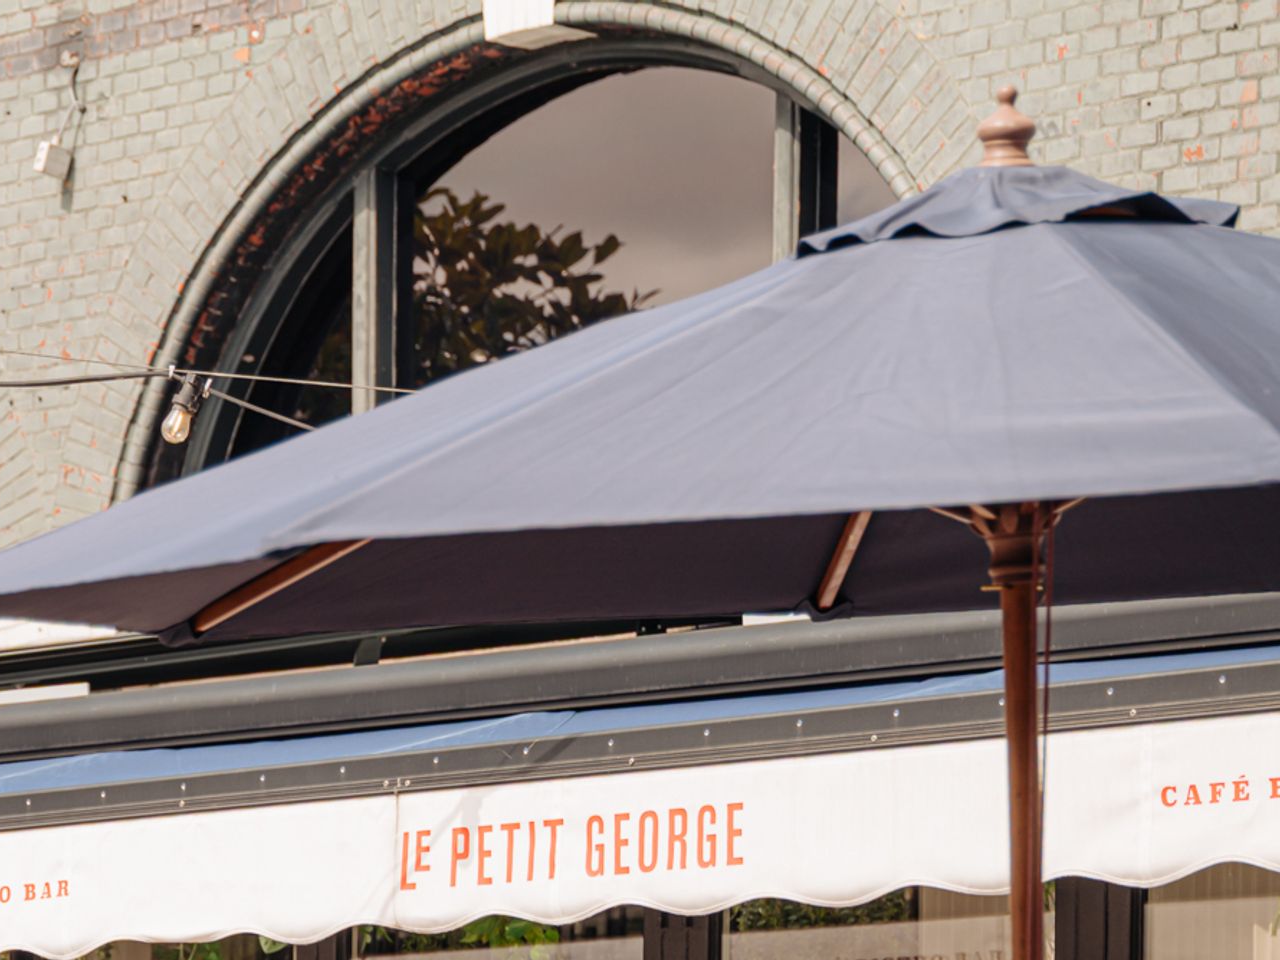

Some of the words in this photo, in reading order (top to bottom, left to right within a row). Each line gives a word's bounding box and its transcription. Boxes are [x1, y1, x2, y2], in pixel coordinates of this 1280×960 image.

[1160, 774, 1250, 808] CAFÉ
[399, 828, 432, 891] LE
[450, 818, 565, 888] PETIT
[584, 802, 744, 878] GEORGE
[23, 879, 69, 902] BAR
